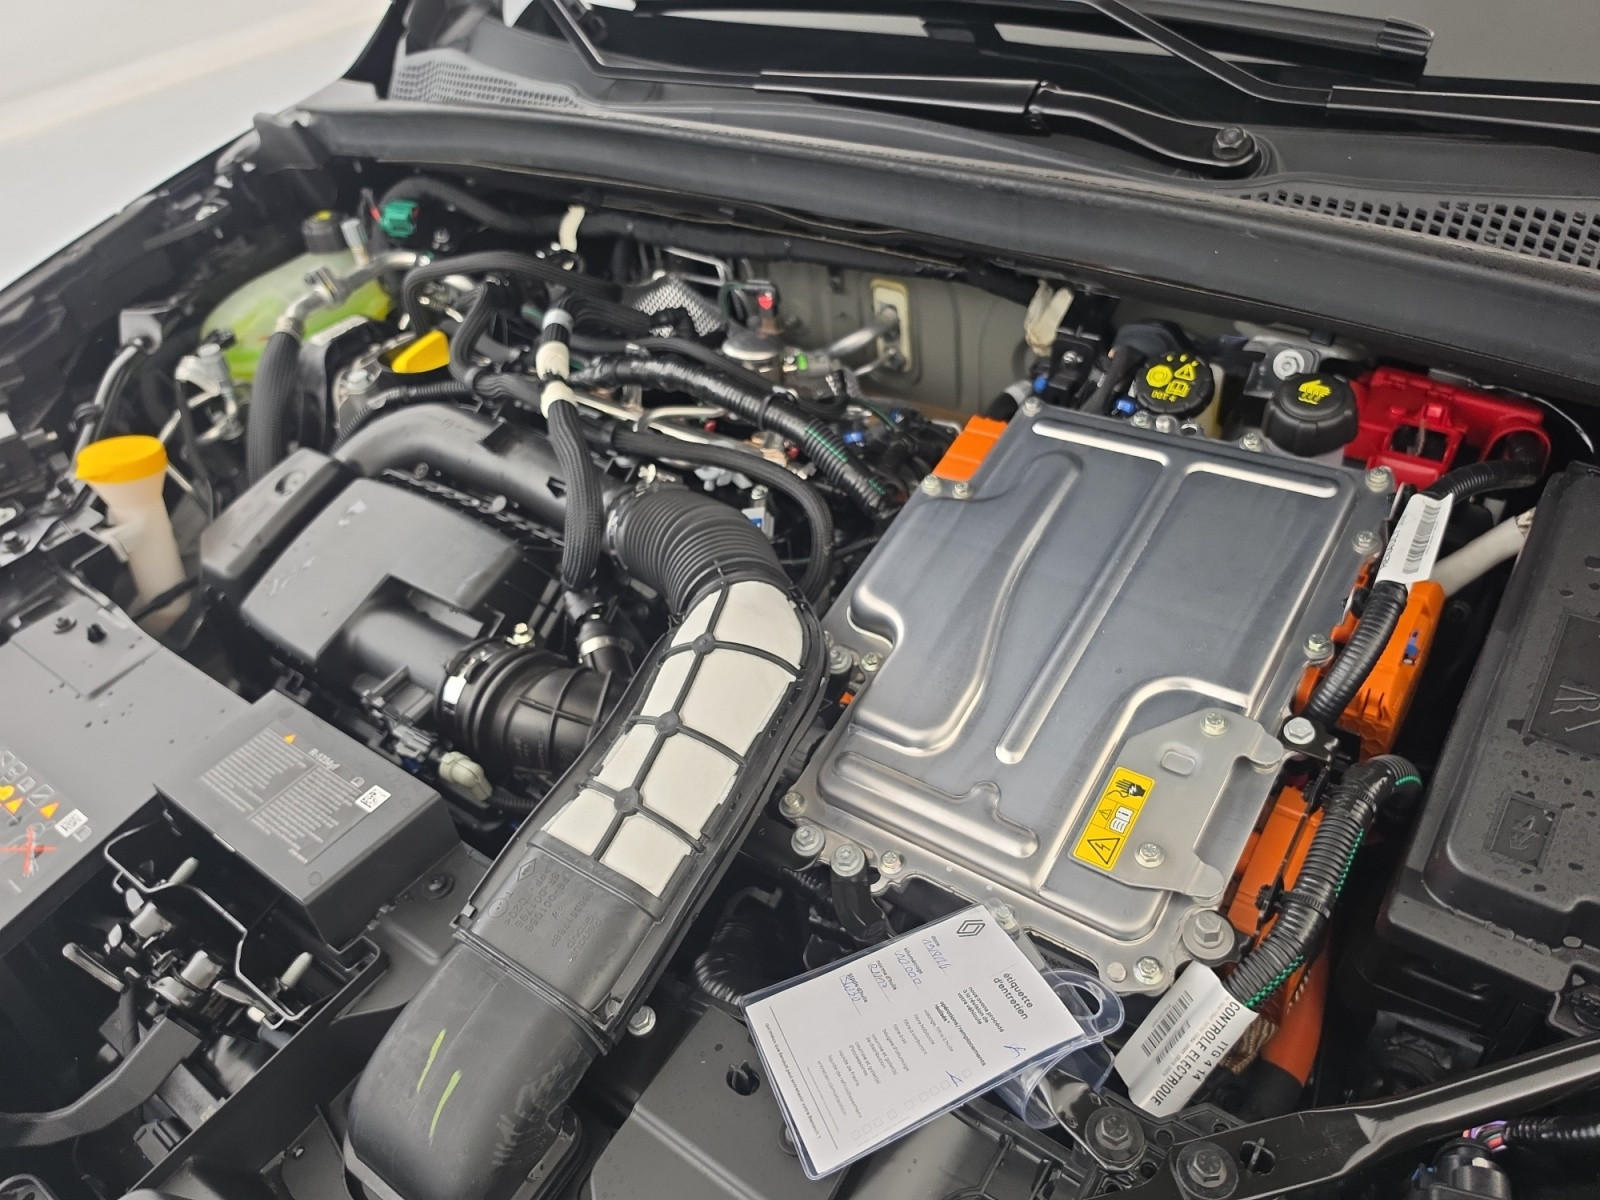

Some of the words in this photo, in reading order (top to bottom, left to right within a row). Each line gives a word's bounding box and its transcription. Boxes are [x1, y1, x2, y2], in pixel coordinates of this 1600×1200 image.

[957, 992, 967, 1005] votre
[966, 1004, 982, 1024] véhicule
[968, 986, 978, 998] nous
[976, 997, 989, 1012] avons
[986, 1011, 1004, 1032] procédé
[993, 977, 1028, 1020] d'entretien
[1003, 973, 1033, 1008] étiquette
[1197, 1001, 1241, 1052] CONTROLE
[1150, 1049, 1200, 1106] ELECTRIQUE
[1192, 1069, 1206, 1081] 14
